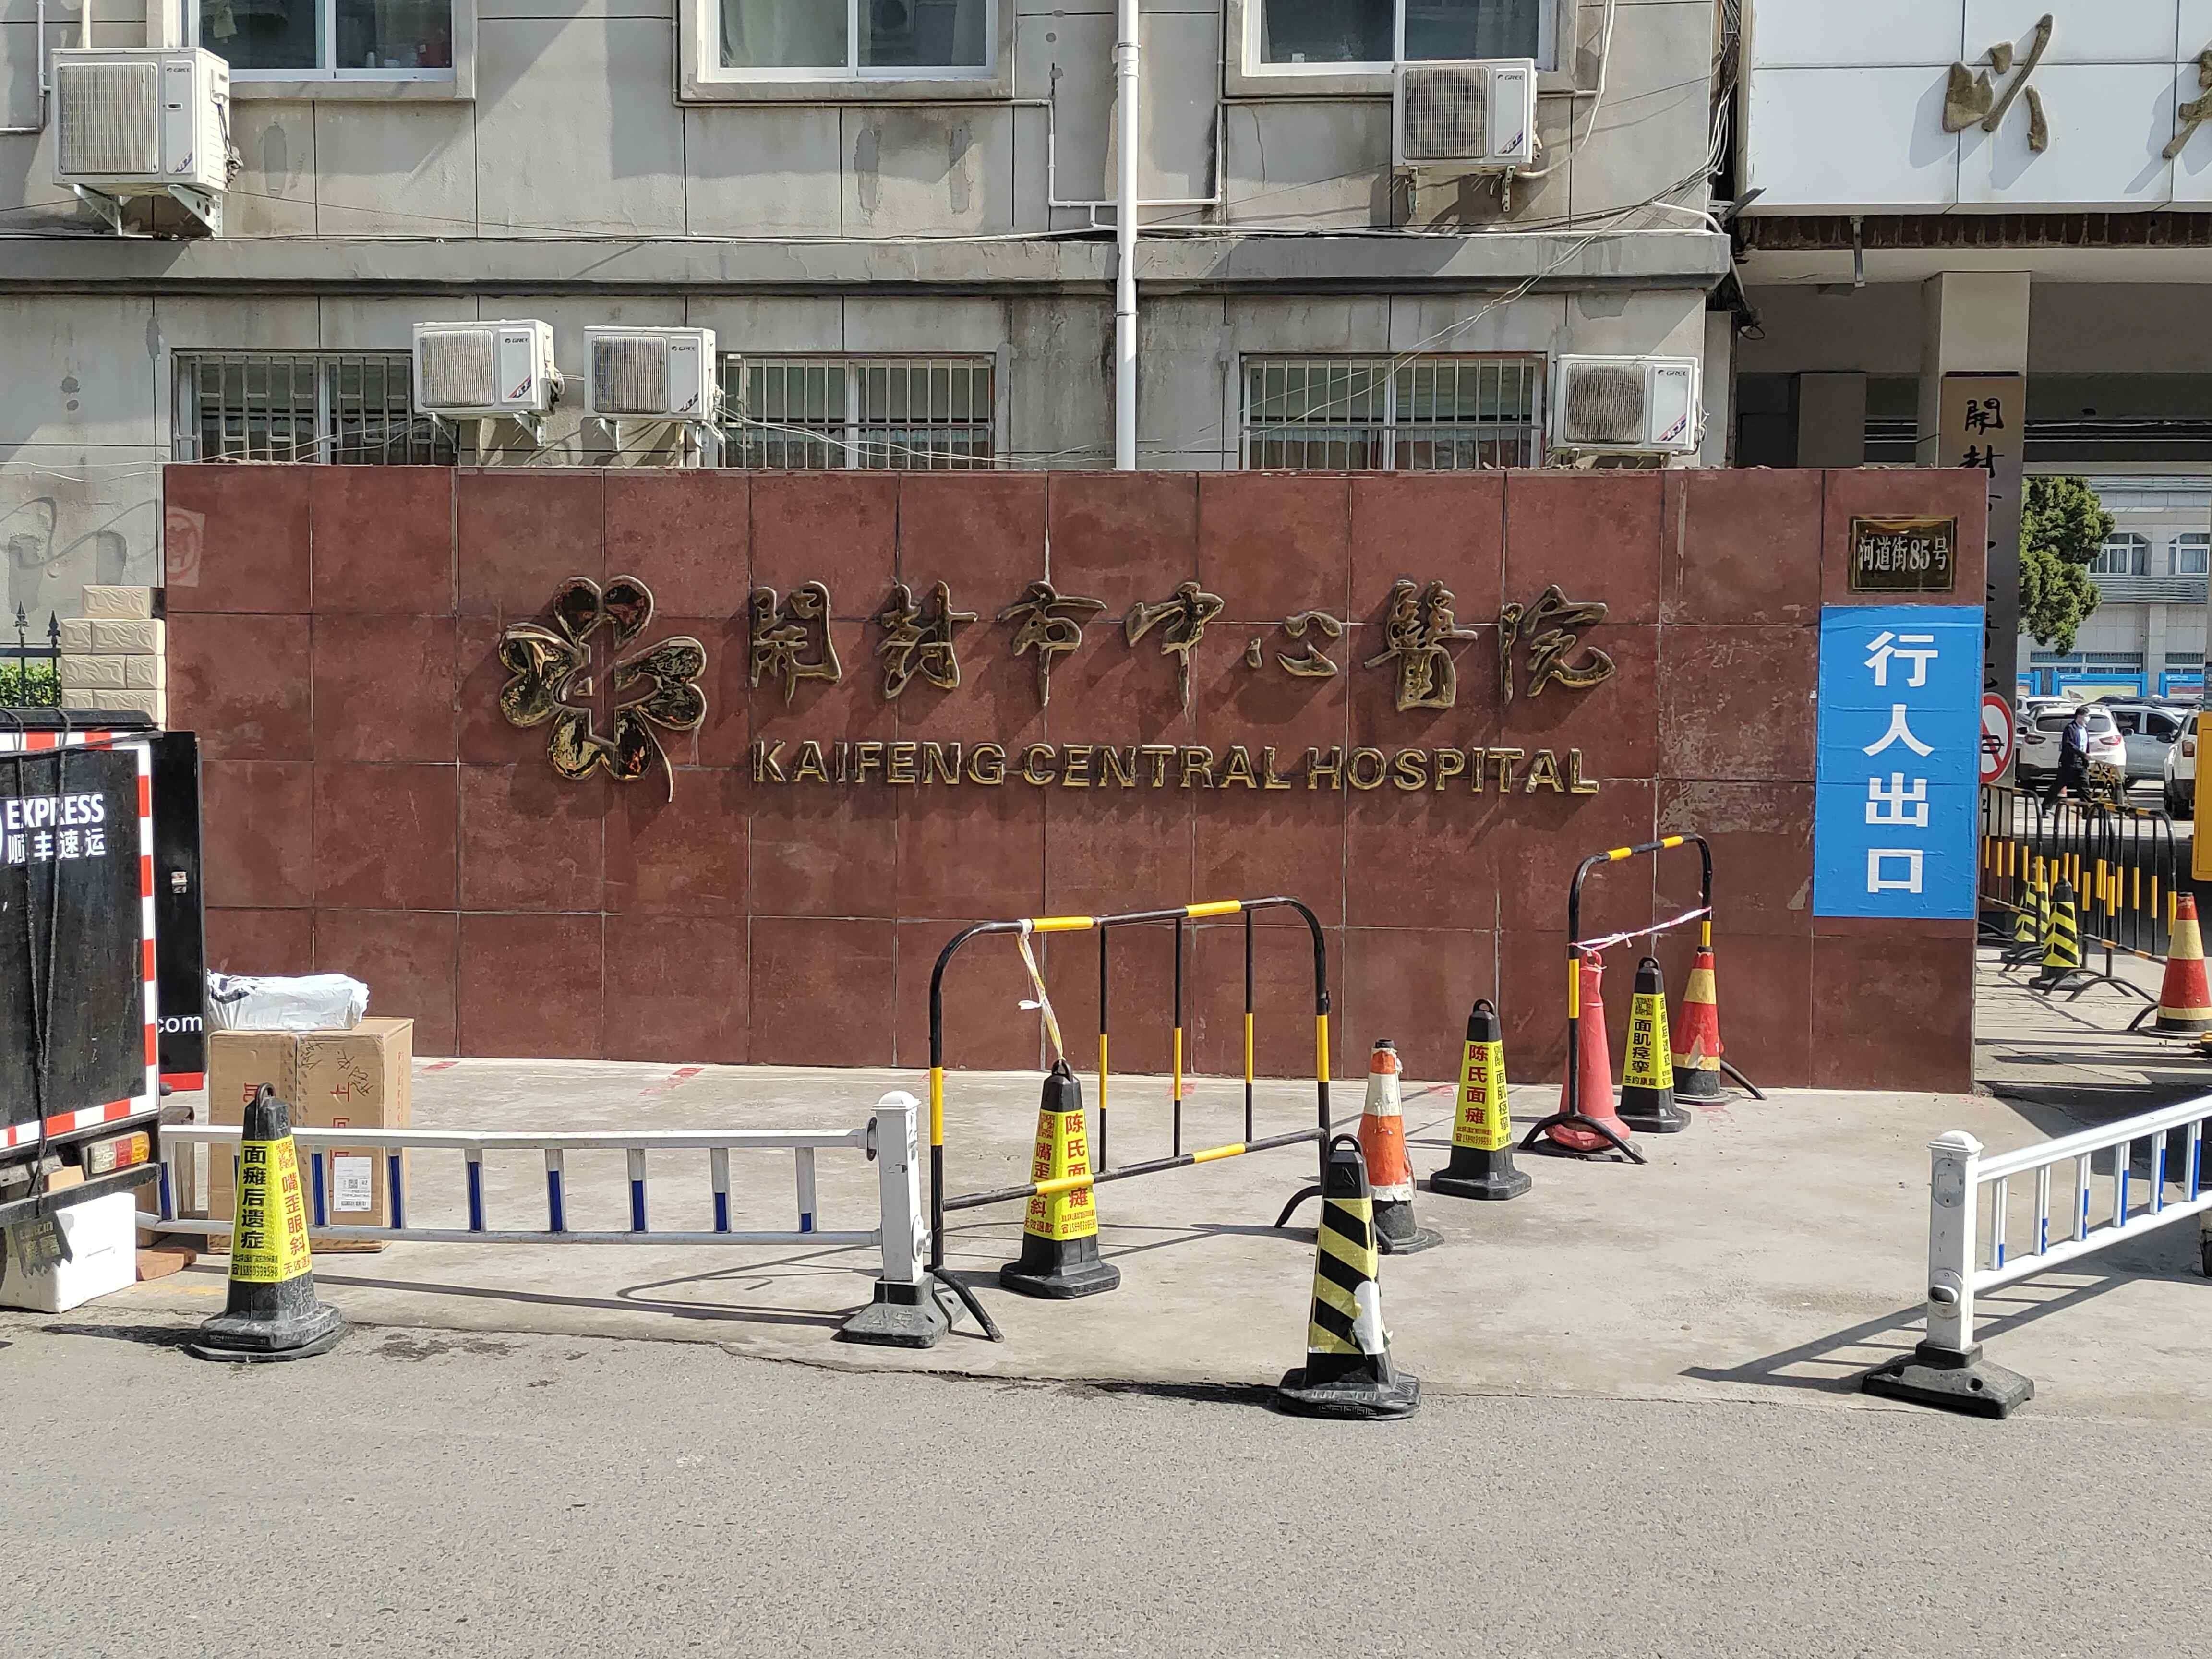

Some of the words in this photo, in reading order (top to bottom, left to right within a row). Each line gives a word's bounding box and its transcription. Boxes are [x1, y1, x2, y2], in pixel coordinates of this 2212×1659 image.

[1859, 535, 1948, 572] 河道街85号
[750, 740, 1006, 785] KAIFENG
[1022, 743, 1291, 790] CENTRAL
[1307, 745, 1600, 794] HOSPITAL
[1862, 630, 1939, 893] 行人出口
[7, 793, 105, 830] EXPRESS
[7, 828, 106, 864] 顺丰速运
[1632, 1018, 1652, 1073] 面肌痉挛
[1465, 1044, 1490, 1124] 陈氏面瘫
[240, 1145, 267, 1249] 面瘫后遗症
[1031, 1142, 1052, 1218] 嘴歪斜
[1065, 1113, 1089, 1208] 陈氏面瘫
[281, 1172, 306, 1256] 嘴歪眼斜
